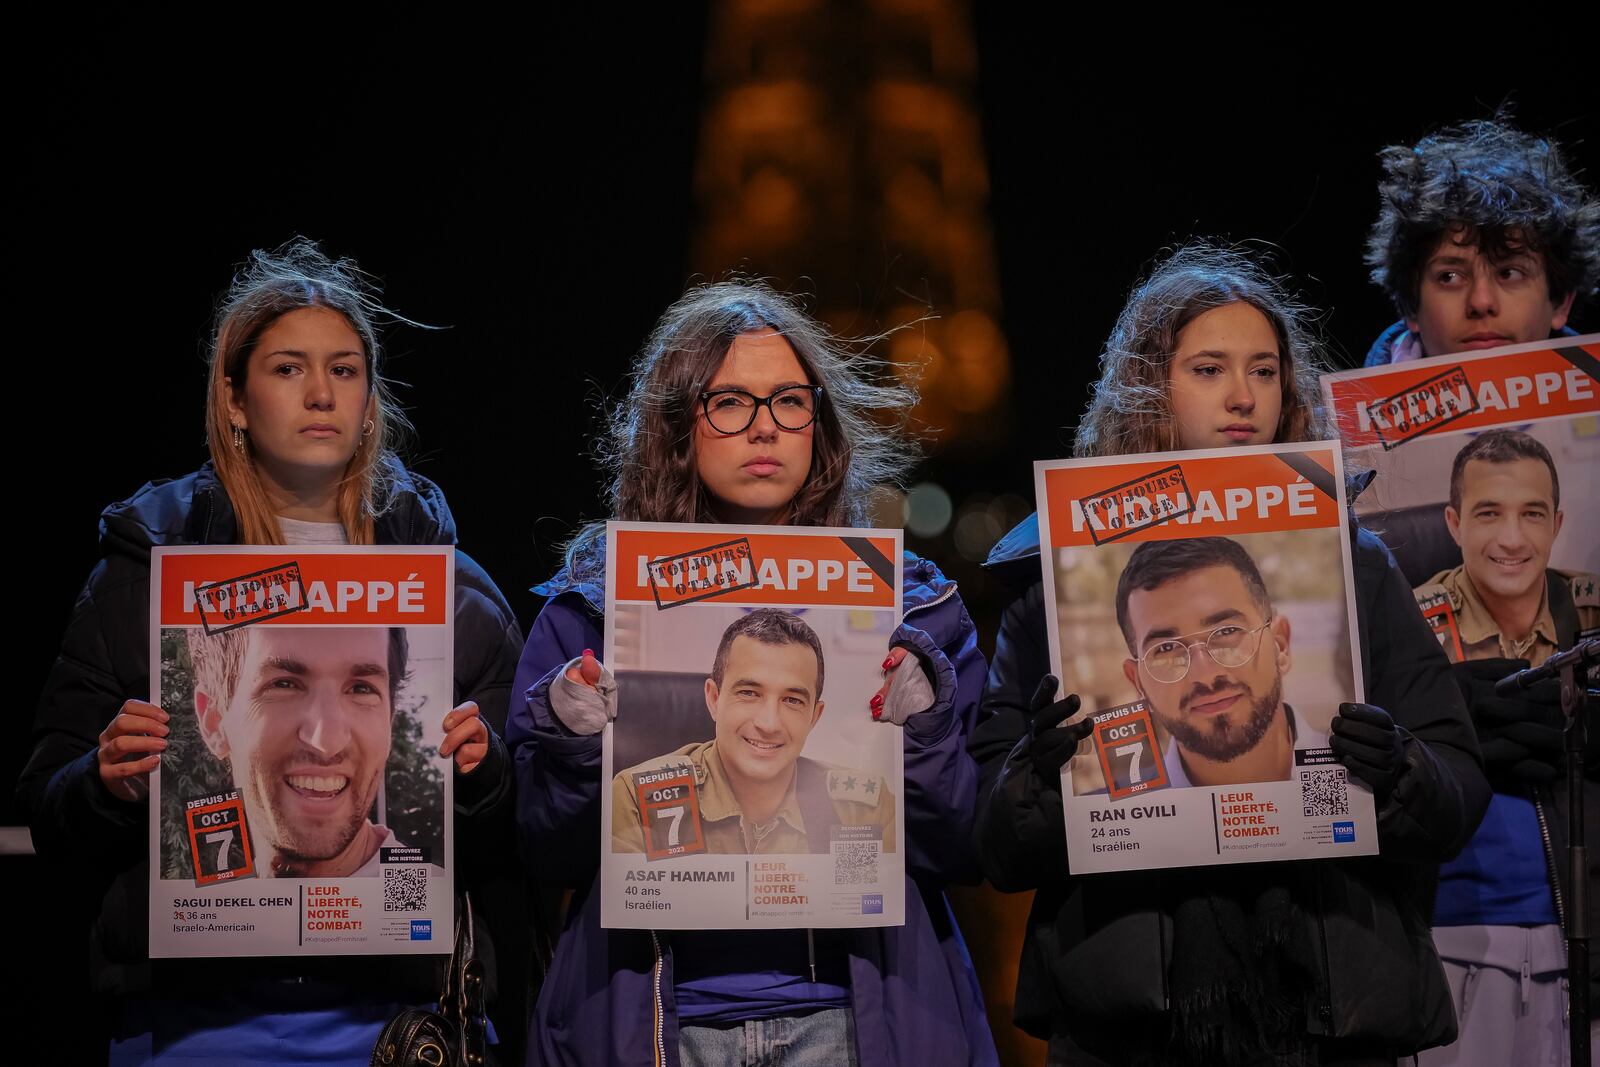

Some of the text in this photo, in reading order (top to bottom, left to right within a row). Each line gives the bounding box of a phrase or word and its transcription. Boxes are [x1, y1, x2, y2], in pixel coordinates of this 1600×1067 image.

[1374, 373, 1465, 420] TOUJOURS
[1397, 399, 1458, 433] OTAGE
[1087, 472, 1182, 516] TOUJOURS
[1071, 476, 1317, 532] KIDNAPPÉ
[1110, 498, 1174, 530] OTAGE
[655, 545, 749, 580] TOUJOURS
[202, 569, 297, 606] TOUJOURS
[675, 569, 738, 596] OTAGE
[183, 573, 424, 613] KIDNAPPÉ
[223, 592, 288, 621] OTAGE
[1093, 703, 1144, 724] DEPUIS LE
[1109, 723, 1137, 740] OCT
[1115, 742, 1144, 784] 7
[638, 768, 689, 785] DEPUIS LE
[1130, 783, 1148, 792] 2023
[187, 791, 239, 809] DEPUIS LE
[652, 788, 680, 802] OCT
[1220, 793, 1254, 803] LEUR
[1090, 805, 1177, 823] RAN GVILI
[1221, 800, 1278, 815] LIBERTÉ,
[201, 810, 230, 826] OCT
[1223, 815, 1266, 827] NOTRE
[656, 806, 685, 847] 7
[1091, 827, 1131, 838] 24 ans
[1223, 826, 1280, 838] COMBAT!
[205, 829, 234, 871] 7
[668, 846, 685, 854] 2023
[1092, 841, 1140, 853] Israélien
[753, 863, 787, 871] LEUR
[216, 871, 235, 880] 2023
[625, 870, 735, 882] ASAF HAMAMI
[307, 886, 340, 896] LEUR
[625, 886, 661, 896] 40 ans
[753, 884, 796, 893] NOTRE
[173, 897, 293, 908] SAGUI DEKEL CHEN
[307, 895, 362, 909] LIBERTÉ,
[625, 899, 672, 911] Israélien
[753, 895, 809, 905] COMBAT!
[186, 911, 198, 920] 36
[200, 912, 217, 920] ans
[307, 909, 349, 919] NOTRE
[173, 923, 255, 933] Israelo-Americain
[307, 921, 362, 930] COMBAT!
